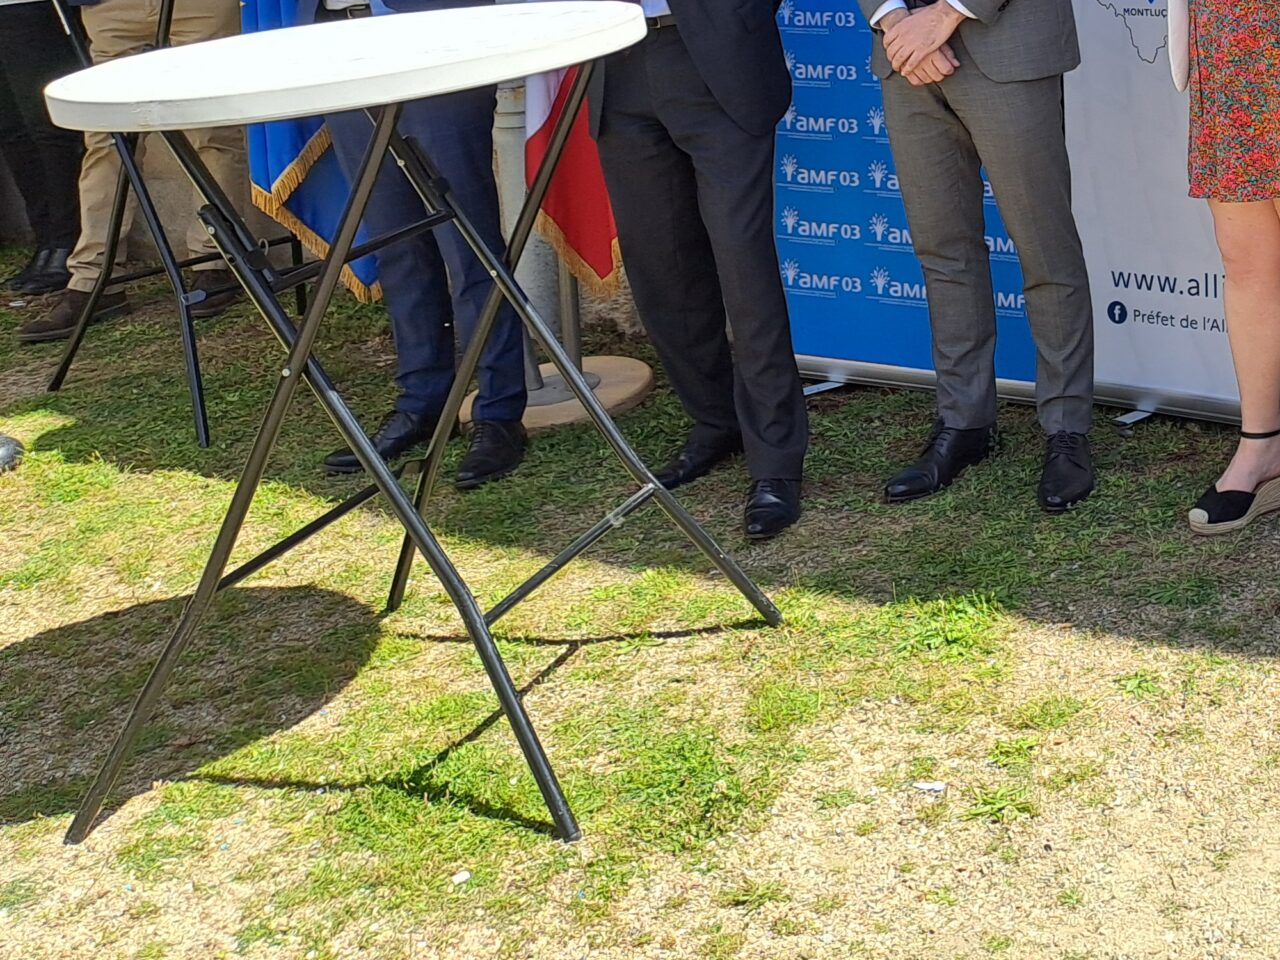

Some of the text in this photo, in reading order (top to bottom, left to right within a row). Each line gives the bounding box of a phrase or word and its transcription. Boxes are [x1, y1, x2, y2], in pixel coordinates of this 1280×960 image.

[1123, 7, 1167, 19] MONTLUÇ
[1133, 309, 1176, 327] Préfet
[1180, 314, 1198, 330] de
